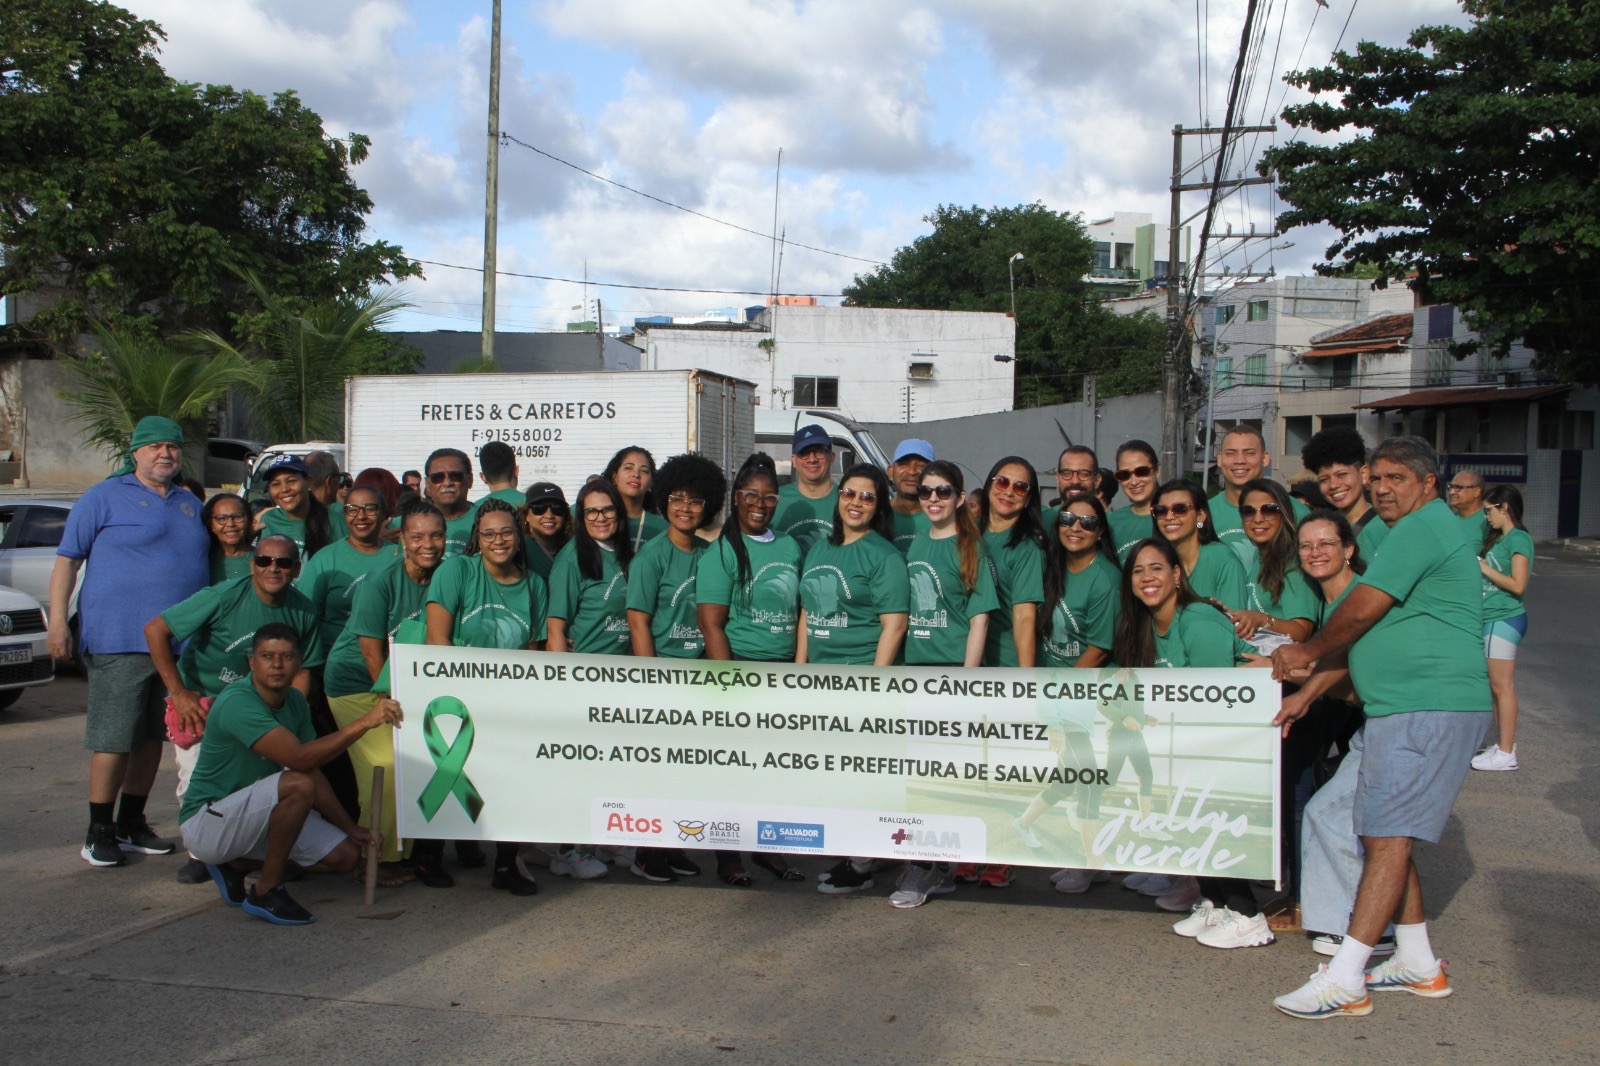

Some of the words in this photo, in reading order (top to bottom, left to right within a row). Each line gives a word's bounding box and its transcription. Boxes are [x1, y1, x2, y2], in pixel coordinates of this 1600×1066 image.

[421, 404, 485, 421] FRETES
[490, 403, 503, 420] &
[508, 402, 617, 420] CARRETOS
[472, 428, 562, 442] F:91558002
[525, 445, 551, 458] 0567
[413, 661, 418, 677] I
[423, 662, 539, 680] CAMINHADA
[545, 666, 567, 681] DE
[572, 665, 762, 691] CONSCIENTIZAÇÃO
[767, 673, 777, 688] E
[783, 673, 881, 692] COMBATE
[886, 677, 918, 694] AO
[924, 674, 1006, 699] CÂNCER
[1012, 682, 1037, 699] DE
[1043, 682, 1129, 706] CABEÇA
[1135, 685, 1145, 701] E
[1152, 685, 1256, 709] PESCOÇO
[588, 706, 698, 727] REALIZADA
[703, 711, 751, 728] PELO
[757, 713, 854, 732] HOSPITAL
[859, 718, 963, 738] ARISTIDES
[968, 722, 1049, 741] MALTEZ
[536, 743, 604, 761] APOIO:
[609, 746, 662, 764] ATOS
[667, 748, 757, 770] MEDICAL,
[763, 753, 819, 771] ACBG
[825, 755, 835, 771] E
[841, 756, 959, 779] PREFEITURA
[965, 763, 988, 780] DE
[994, 764, 1110, 786] SALVADOR
[606, 812, 663, 834] Atos
[879, 816, 925, 826] REALIZAÇÃO:
[1092, 775, 1248, 856] julho
[709, 821, 741, 832] ACBG
[779, 827, 819, 838] SALVADOR
[709, 831, 741, 839] BRASIL
[893, 848, 917, 857] Hospital
[917, 850, 941, 858] Aristides
[1115, 831, 1247, 873] verde
